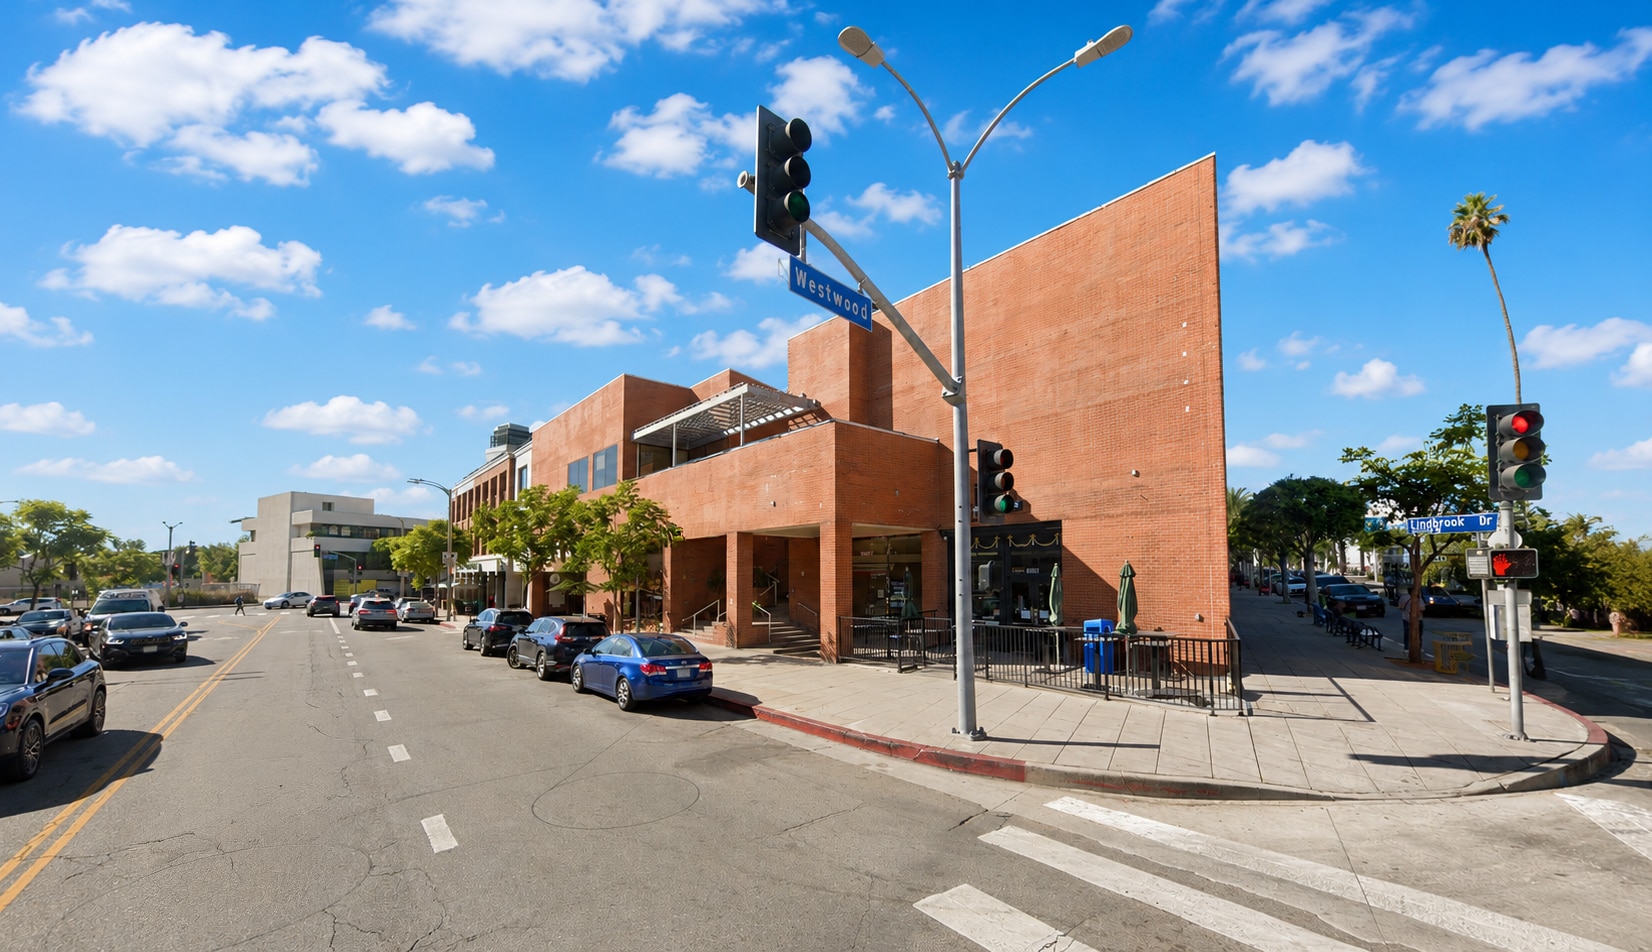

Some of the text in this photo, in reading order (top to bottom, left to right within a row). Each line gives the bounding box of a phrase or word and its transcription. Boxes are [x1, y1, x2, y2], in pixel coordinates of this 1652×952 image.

[795, 266, 867, 320] Westwood
[1410, 515, 1493, 530] Lindbrook Dr
